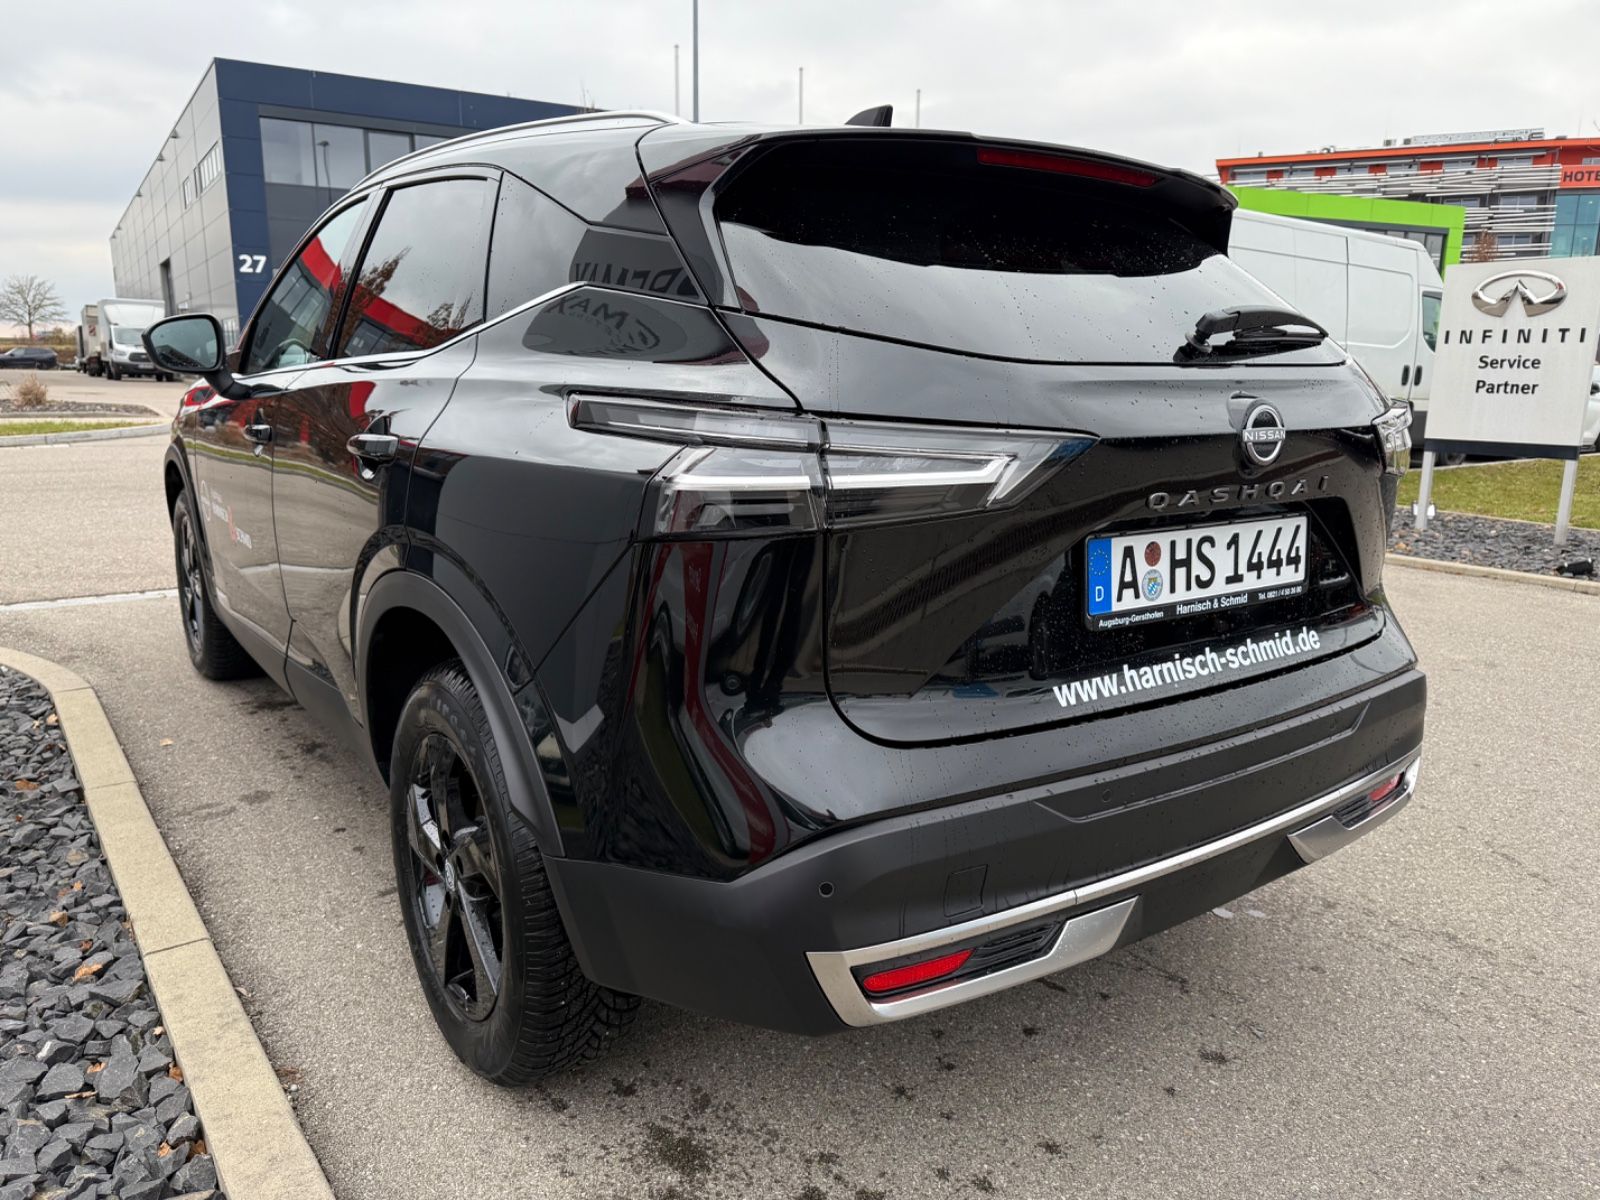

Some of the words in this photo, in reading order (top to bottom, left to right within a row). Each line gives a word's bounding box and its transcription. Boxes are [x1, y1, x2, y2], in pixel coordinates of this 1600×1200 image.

[238, 253, 267, 273] 27
[1444, 327, 1587, 344] INFINITI
[1478, 354, 1541, 370] Service
[1475, 379, 1539, 395] Partner
[1243, 430, 1286, 442] NISSAN
[1146, 475, 1329, 512] QASHQAI
[1116, 545, 1140, 603] A
[1169, 535, 1216, 594] HS
[1225, 524, 1301, 585] 1444
[1095, 585, 1104, 602] D
[1176, 598, 1211, 615] Harnisch
[1212, 596, 1219, 608] &
[1220, 593, 1248, 609] Schmid
[1099, 610, 1164, 628] Augsburg-Gersthofen
[1053, 626, 1321, 707] www.harnisch-schmid.de
